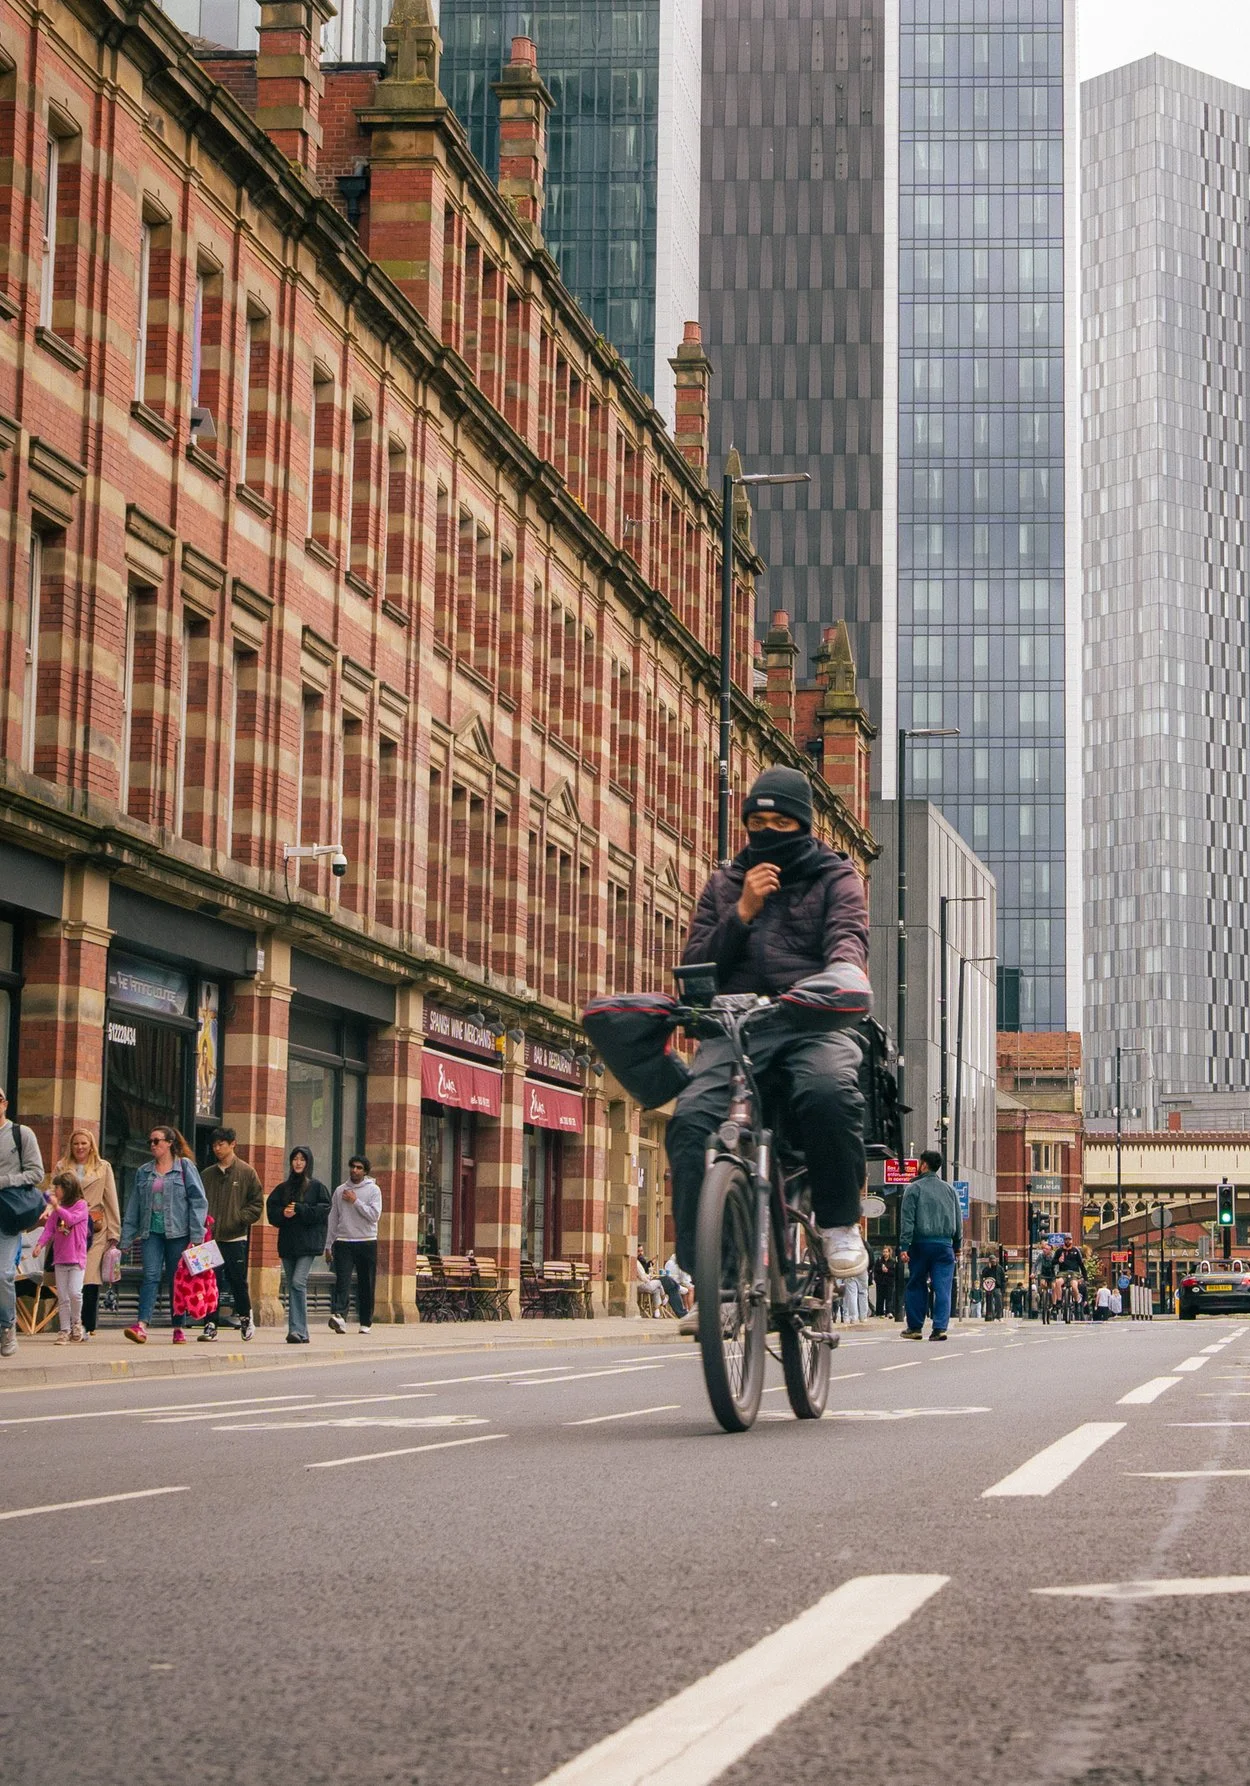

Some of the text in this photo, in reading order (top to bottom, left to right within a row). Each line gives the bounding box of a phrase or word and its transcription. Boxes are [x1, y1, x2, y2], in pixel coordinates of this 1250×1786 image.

[130, 975, 152, 996] TANNING
[153, 983, 176, 1002] LOUNGE
[430, 1010, 450, 1037] SPANISH
[451, 1018, 463, 1041] WINE
[464, 1021, 491, 1050] MERCHANTS
[533, 1045, 543, 1066] BAR
[548, 1050, 573, 1075] RESTAURAN
[1148, 1248, 1200, 1257] ALAS
